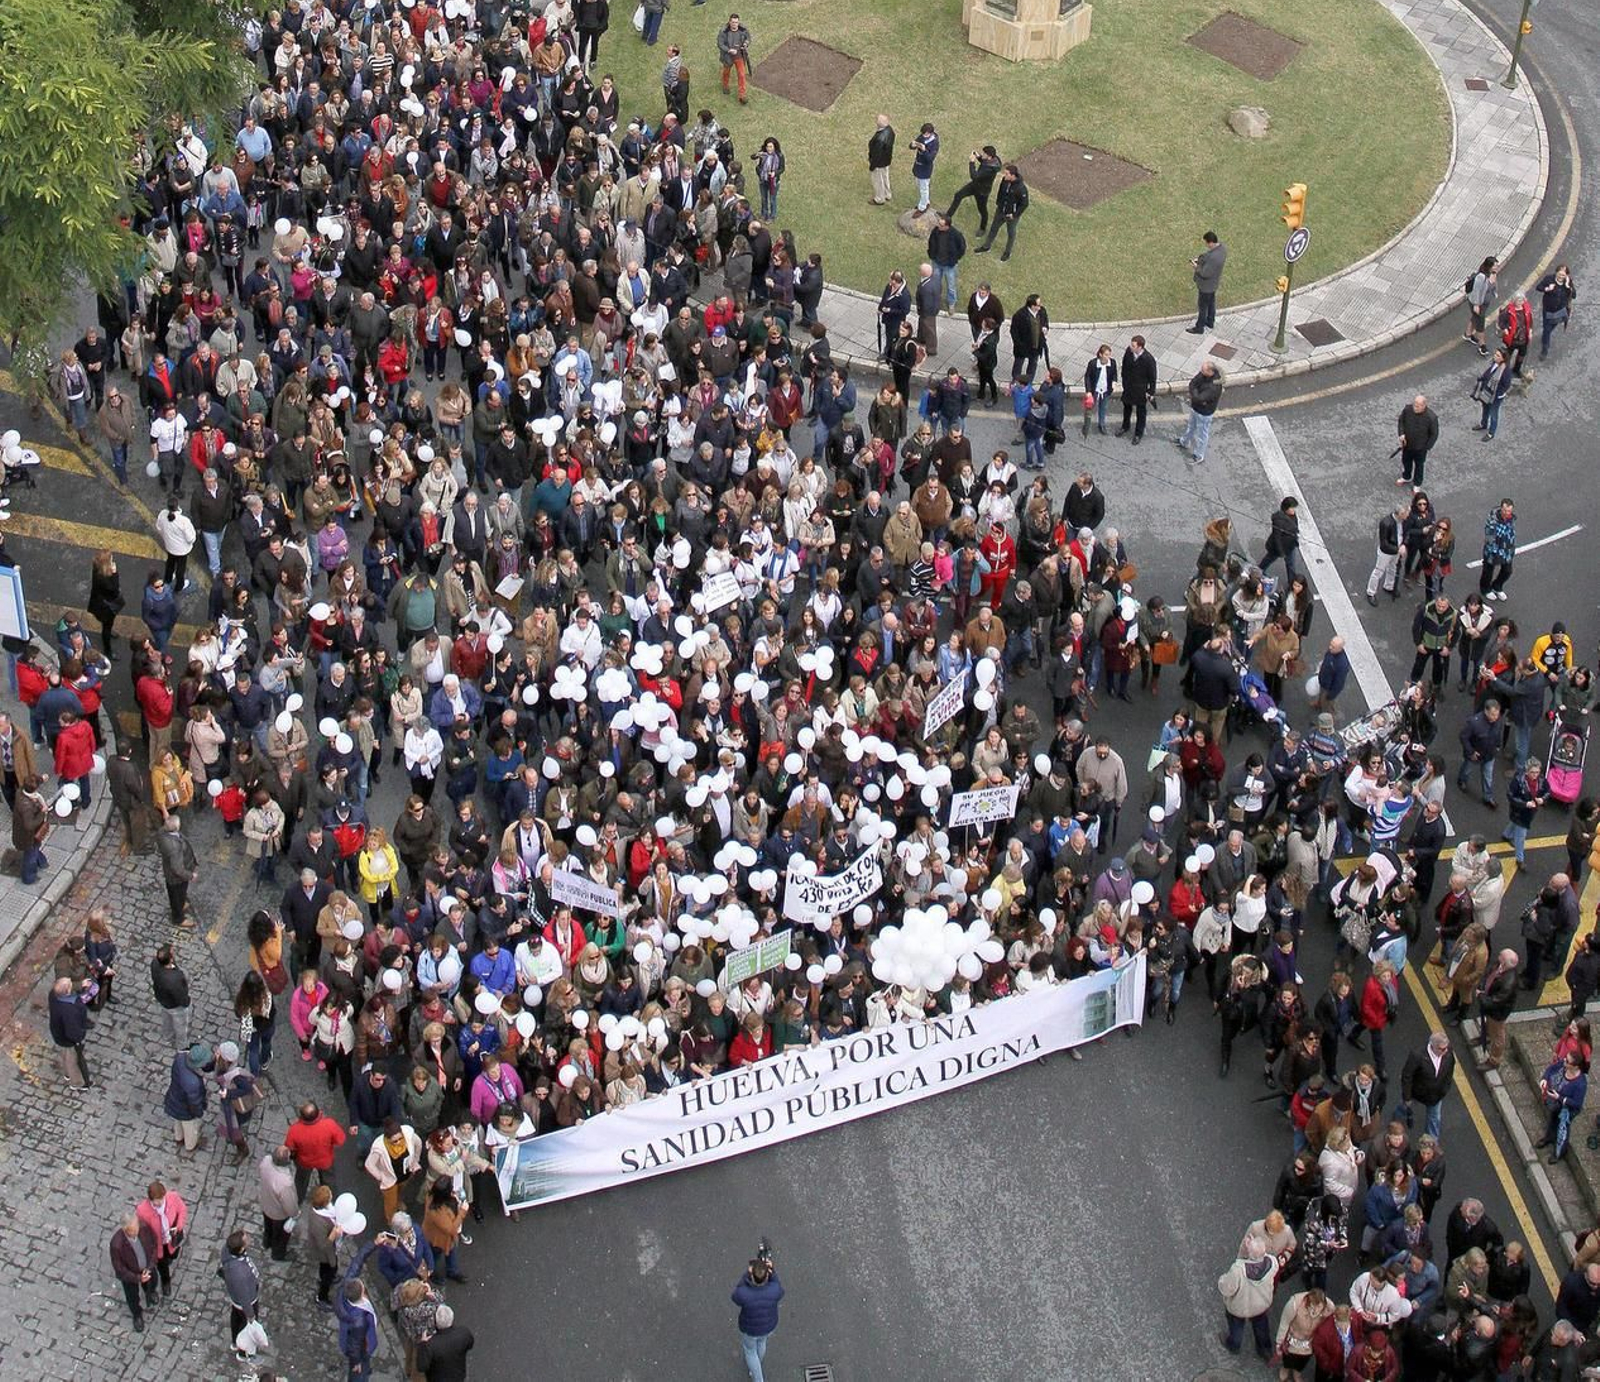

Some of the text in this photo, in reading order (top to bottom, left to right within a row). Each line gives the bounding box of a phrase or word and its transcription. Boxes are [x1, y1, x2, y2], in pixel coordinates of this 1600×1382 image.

[798, 886, 824, 903] 430
[817, 905, 832, 913] DE
[679, 1014, 978, 1118] HUELVA, POR UNA
[621, 1034, 1042, 1174] SANIDAD PÚBLICA DIGNA
